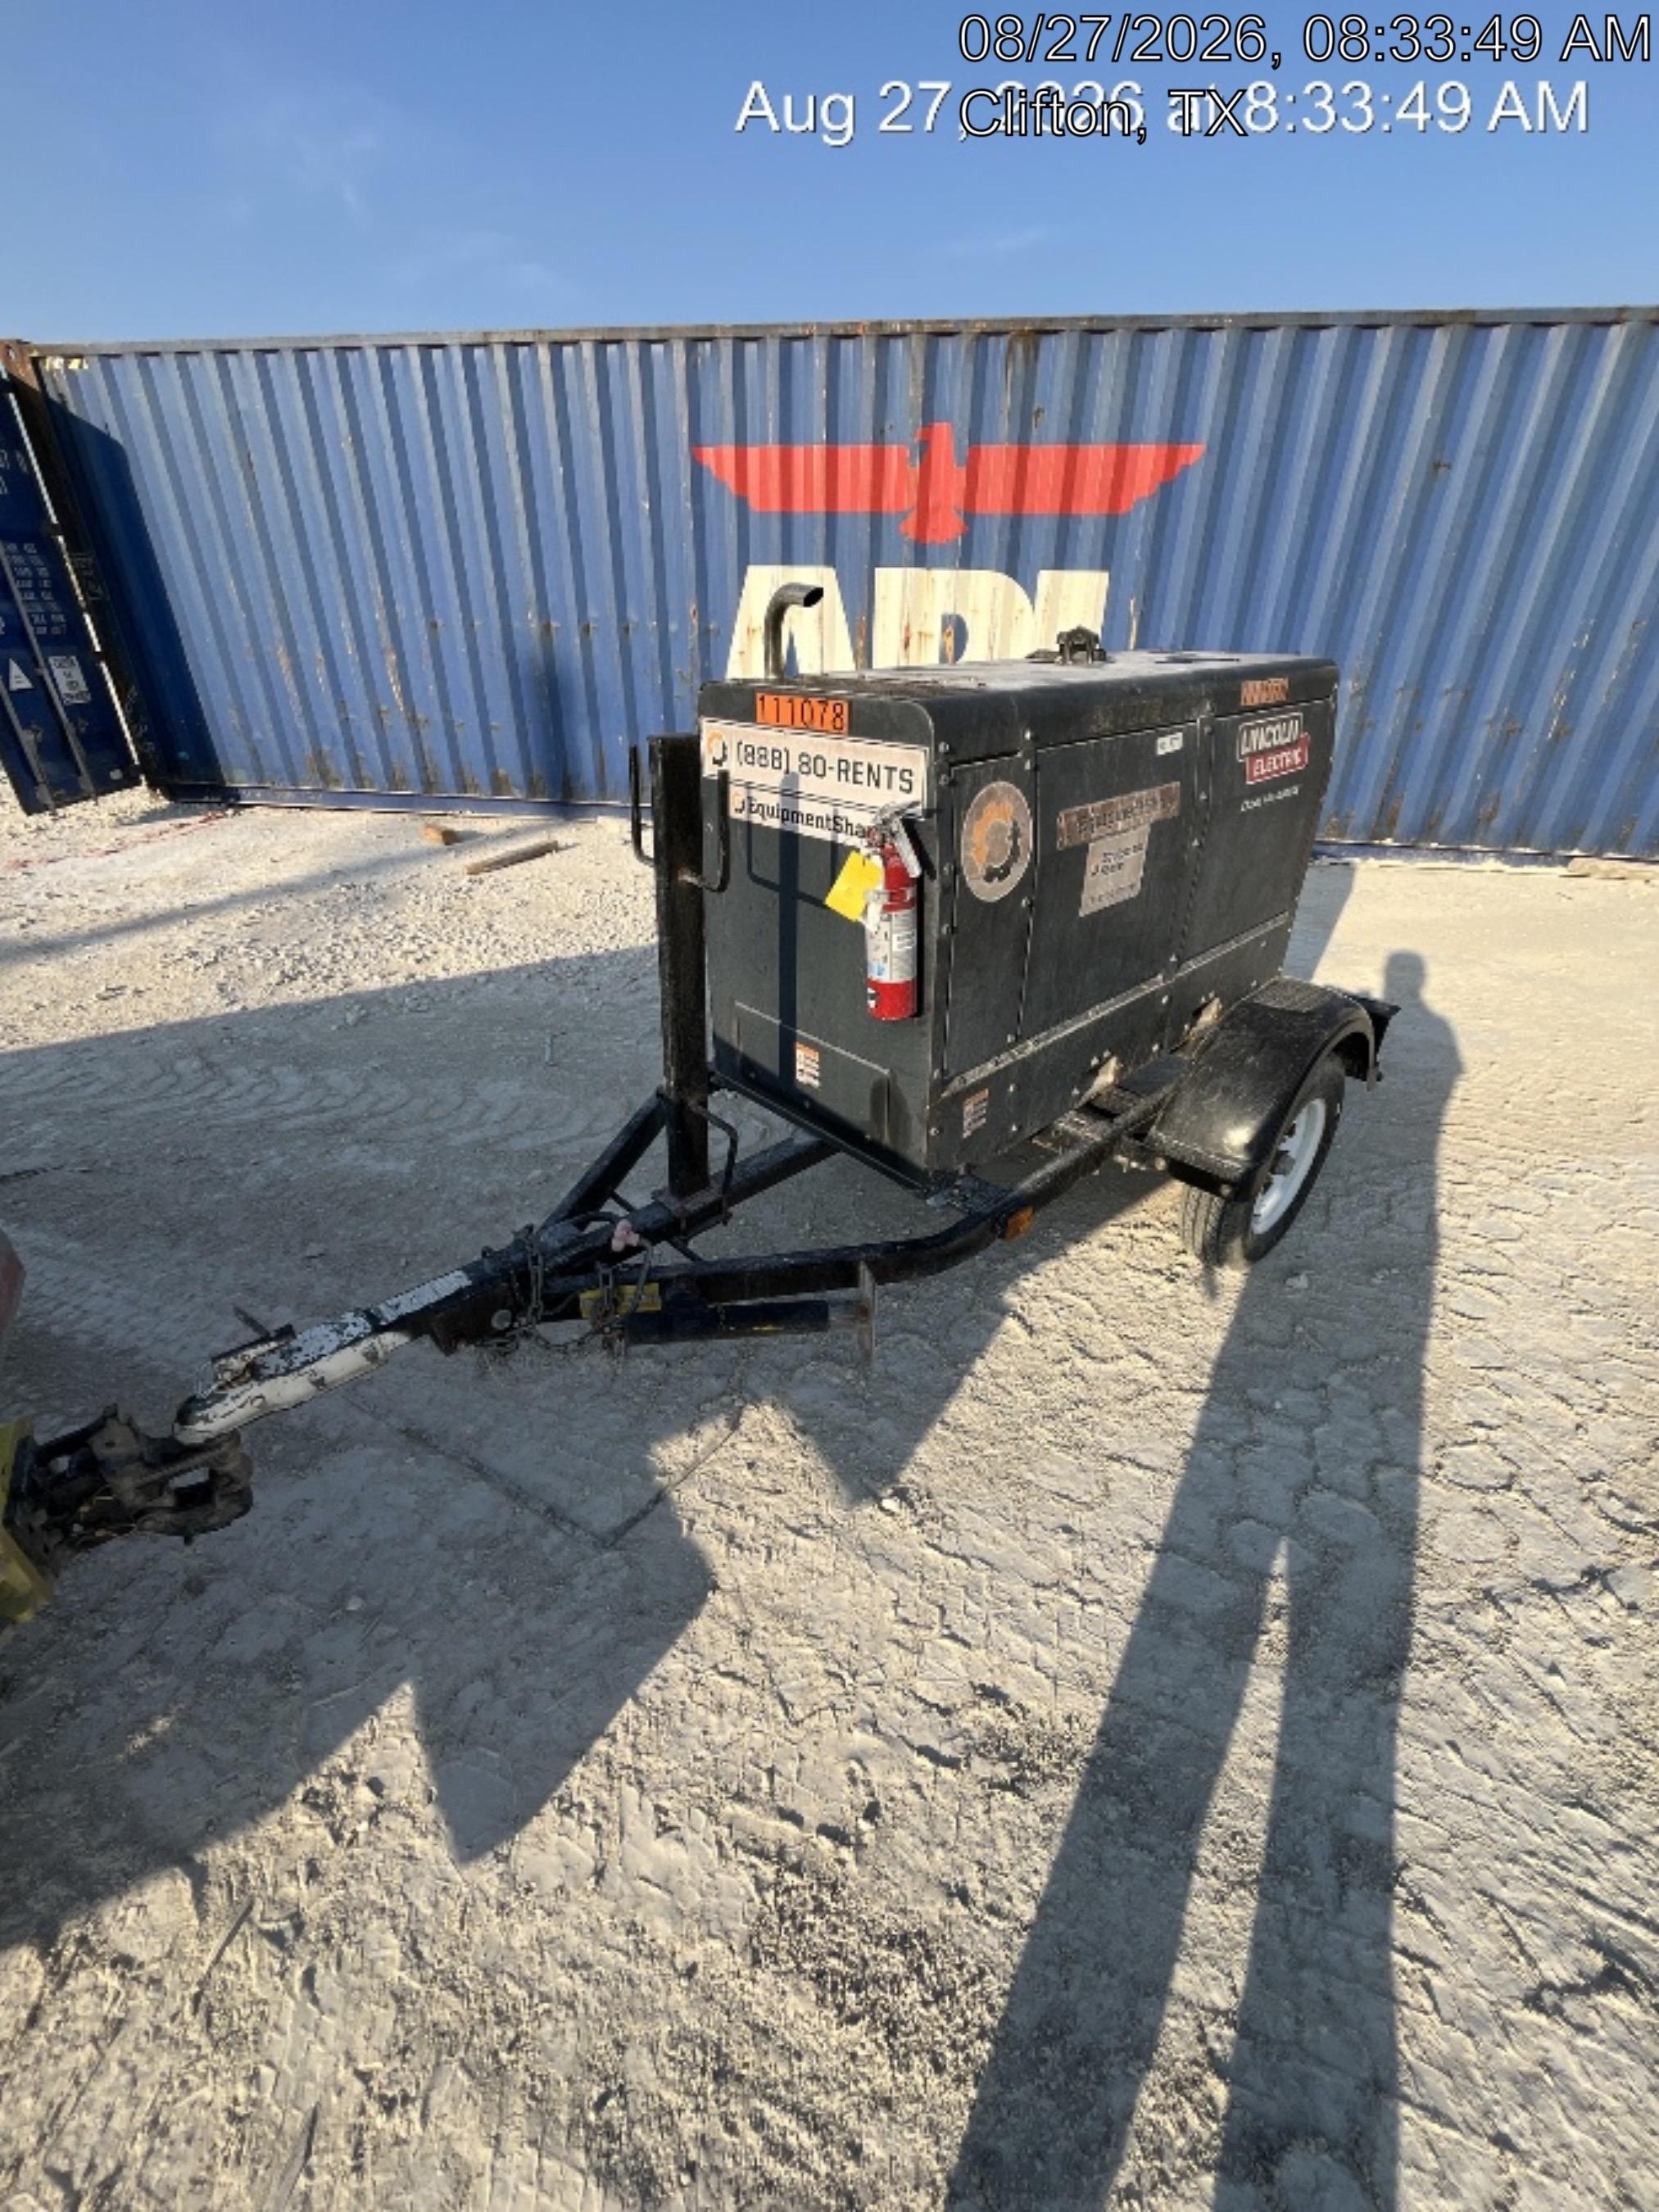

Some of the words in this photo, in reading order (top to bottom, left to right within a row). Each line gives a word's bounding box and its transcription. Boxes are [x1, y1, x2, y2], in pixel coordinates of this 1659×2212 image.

[759, 694, 845, 731] 111078
[737, 740, 790, 775] (888)
[798, 751, 914, 795] 80-RENTS
[747, 796, 870, 840] EquipmentSha
